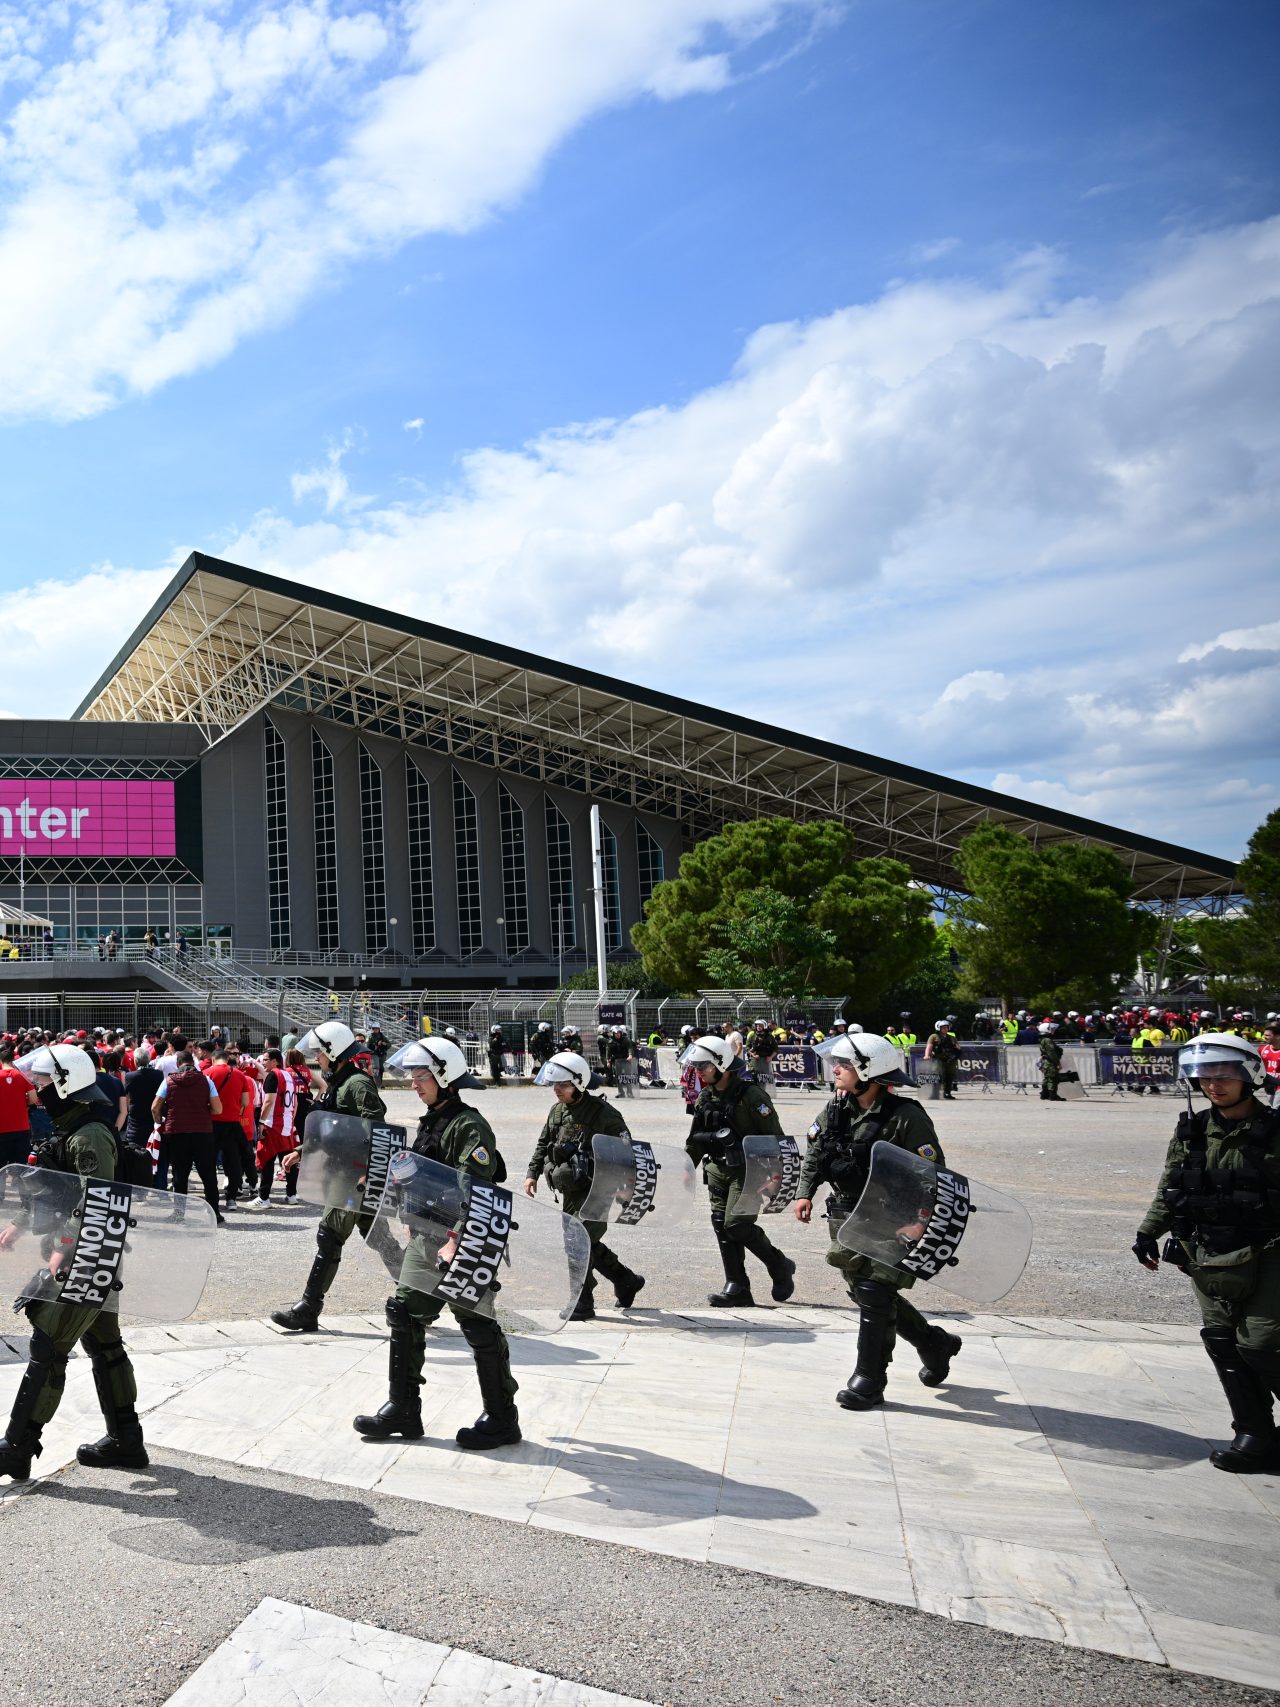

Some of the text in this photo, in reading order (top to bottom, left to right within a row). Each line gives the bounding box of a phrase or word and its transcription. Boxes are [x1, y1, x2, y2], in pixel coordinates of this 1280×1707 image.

[771, 1061, 805, 1074] TERS
[777, 1053, 803, 1061] GAME
[955, 1059, 990, 1072] LORY
[1112, 1055, 1173, 1064] EVERY GAM
[1113, 1063, 1174, 1077] MATTER
[632, 1149, 656, 1220] POLICE
[778, 1142, 800, 1211] POLICE
[921, 1181, 969, 1274] POLICE
[85, 1194, 129, 1303] POLICE
[461, 1195, 511, 1303] POLICE
